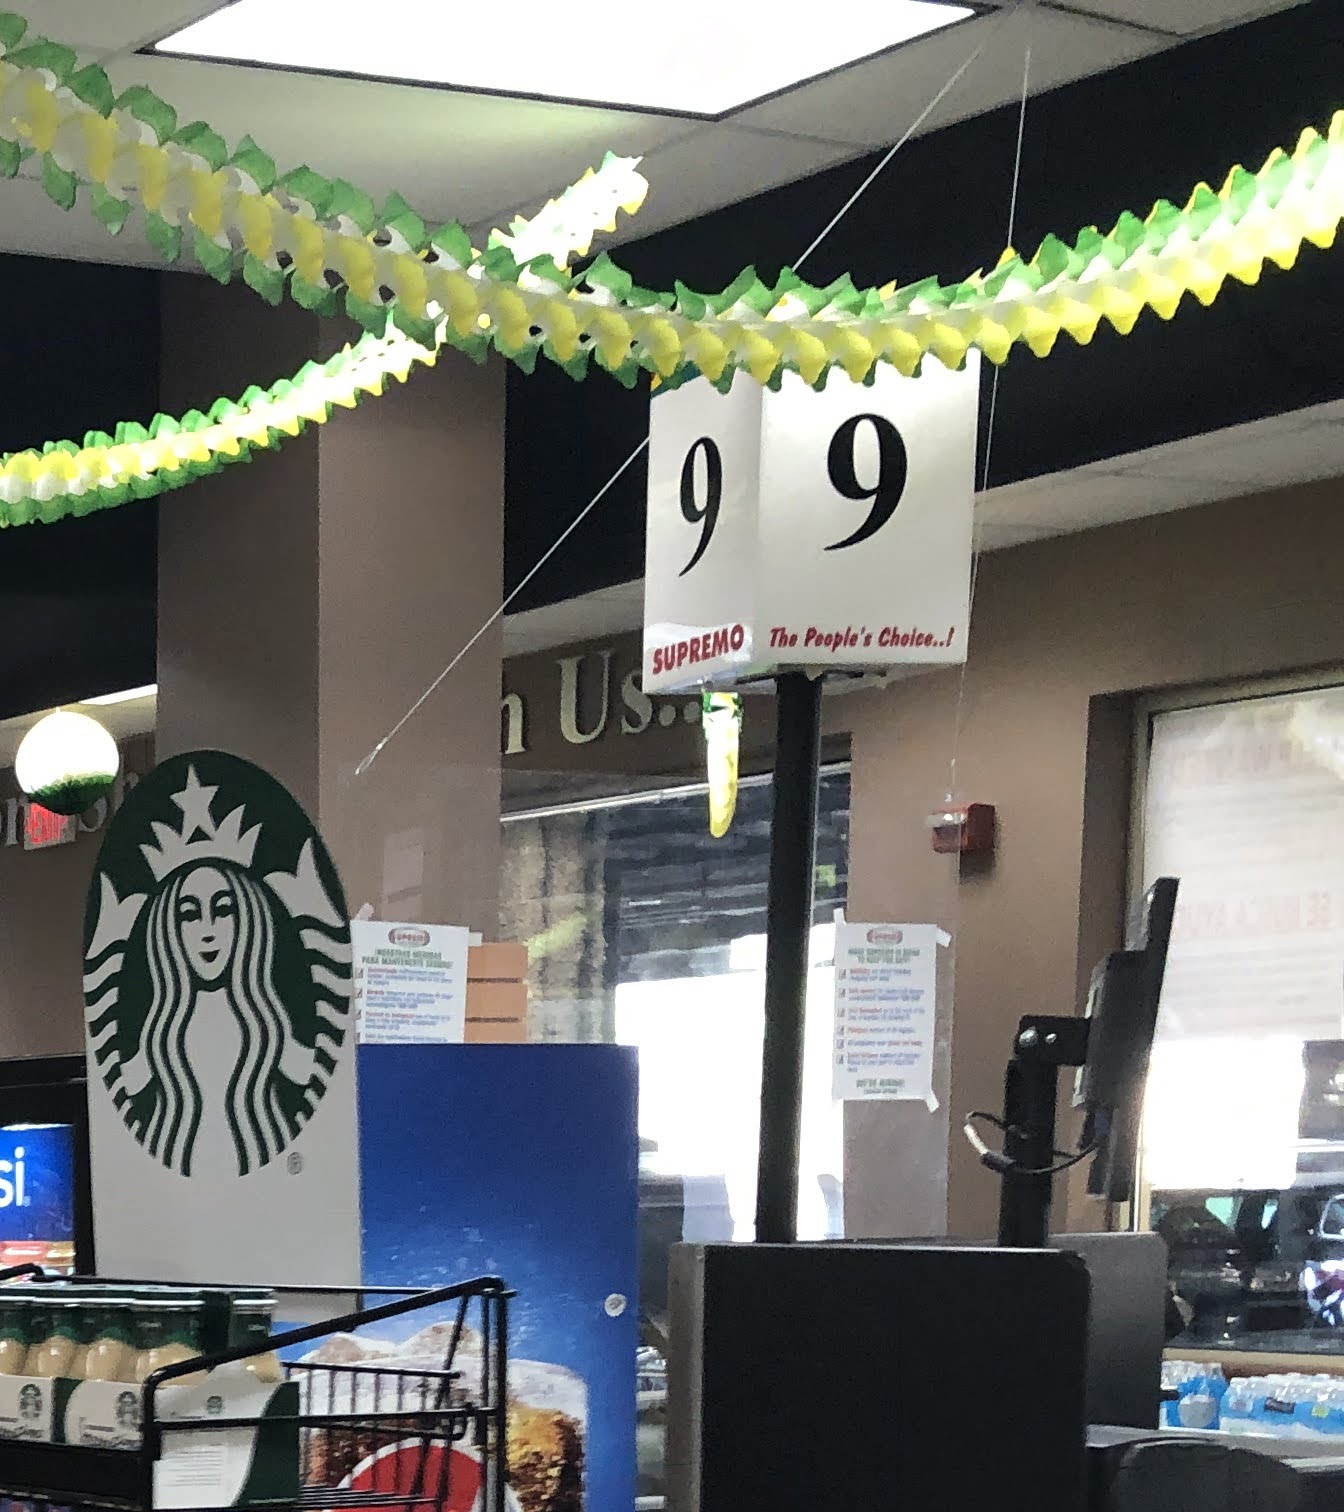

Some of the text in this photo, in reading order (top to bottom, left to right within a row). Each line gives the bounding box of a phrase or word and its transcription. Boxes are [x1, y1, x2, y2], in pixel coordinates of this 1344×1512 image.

[679, 436, 723, 577] 9
[824, 413, 908, 551] 9
[652, 623, 745, 675] SUPREMO
[770, 626, 798, 648] The
[803, 625, 872, 652] People's
